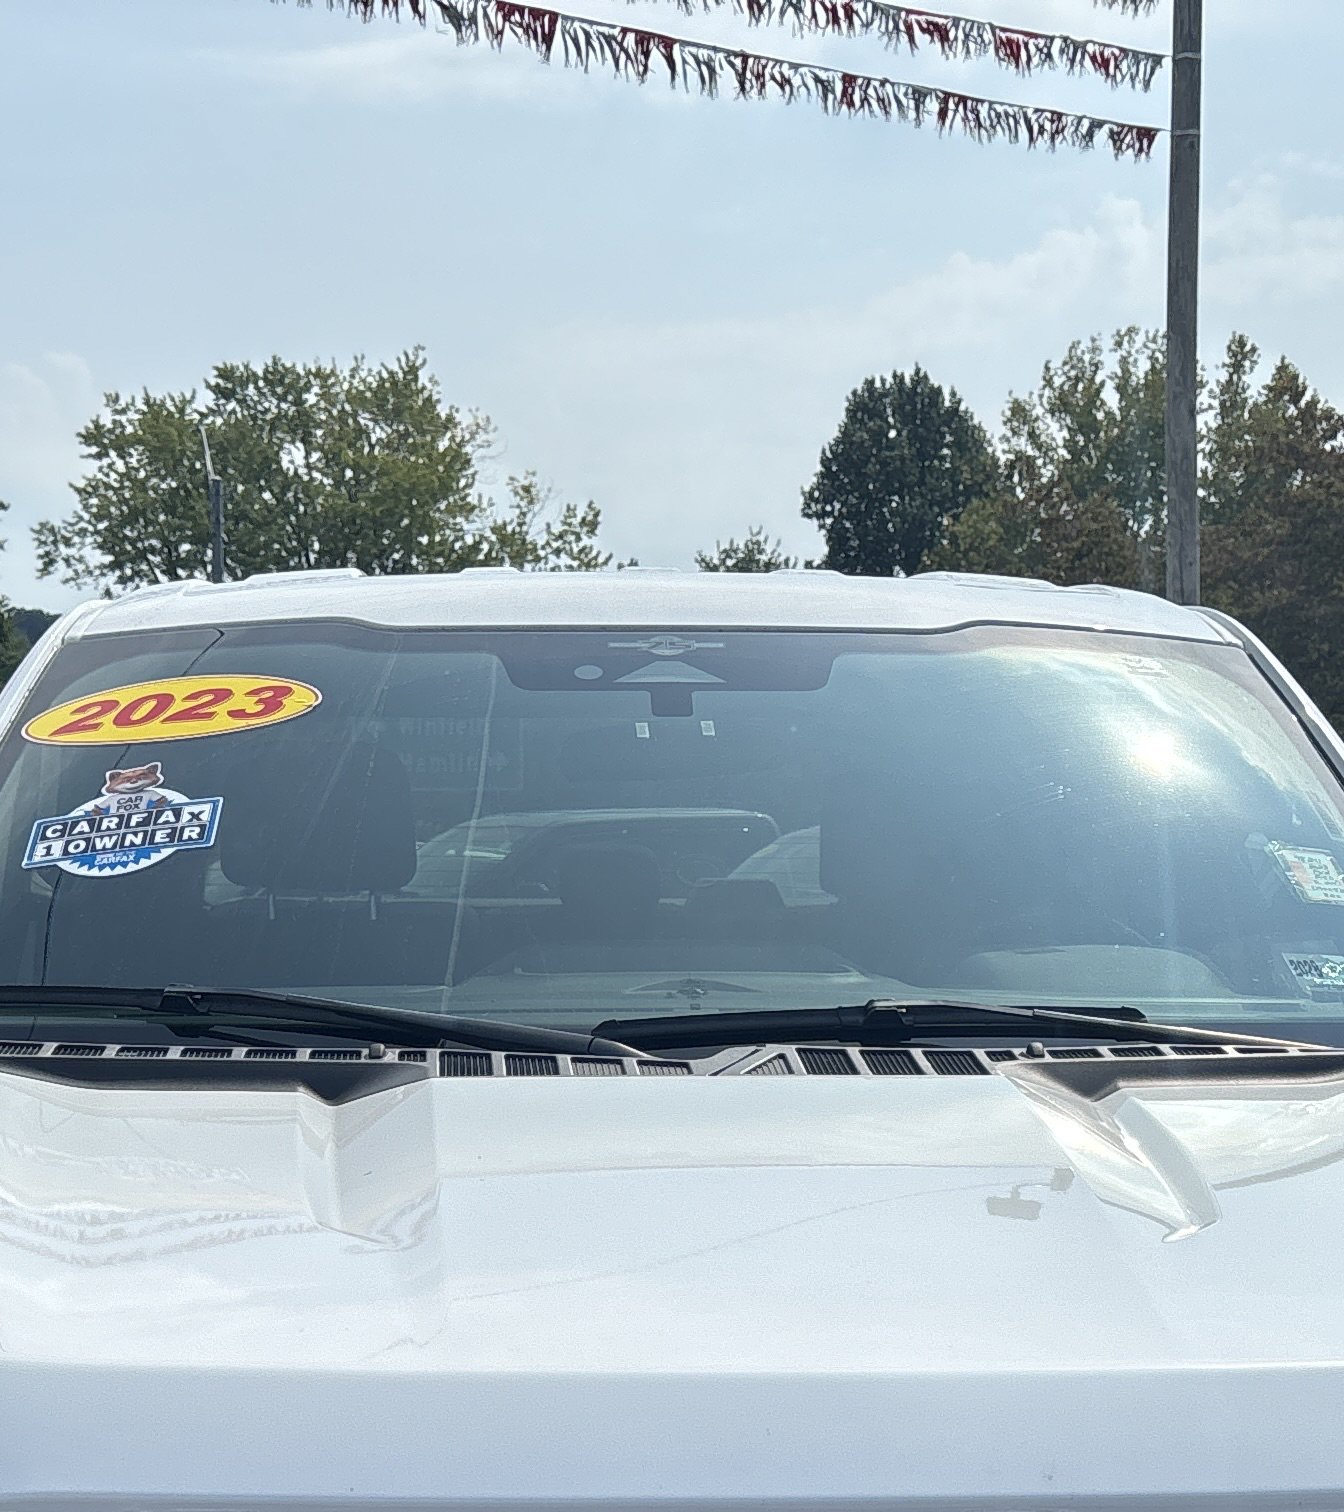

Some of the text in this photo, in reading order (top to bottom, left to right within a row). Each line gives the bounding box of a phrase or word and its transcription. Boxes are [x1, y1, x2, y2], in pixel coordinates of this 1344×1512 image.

[48, 685, 296, 737] 2023
[115, 804, 141, 813] FOX
[116, 795, 144, 805] CAR
[45, 809, 207, 839] CARFAX
[67, 826, 201, 854] OWNER
[94, 854, 136, 866] CARFAX
